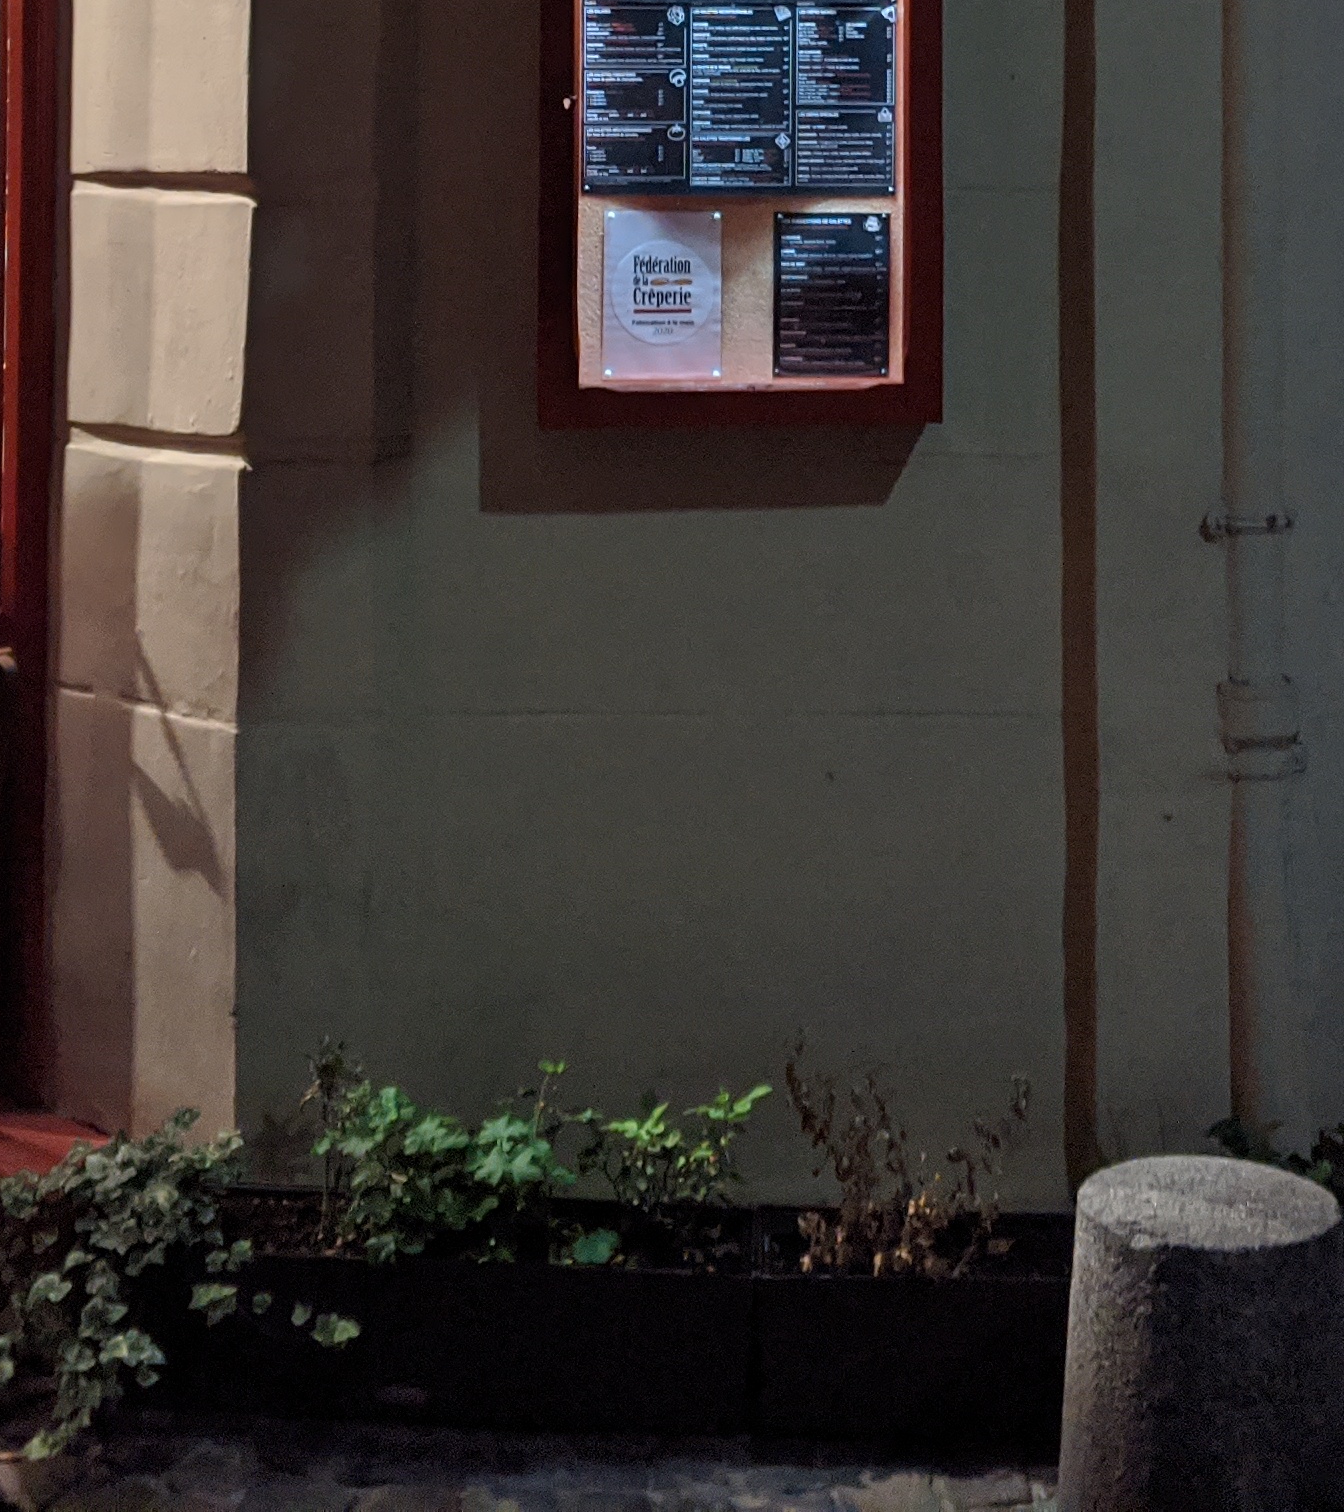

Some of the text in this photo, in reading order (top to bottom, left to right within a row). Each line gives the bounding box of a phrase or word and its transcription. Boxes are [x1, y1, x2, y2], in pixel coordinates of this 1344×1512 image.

[633, 254, 691, 274] Fédération
[633, 274, 649, 286] de la
[633, 287, 692, 307] Crêperie
